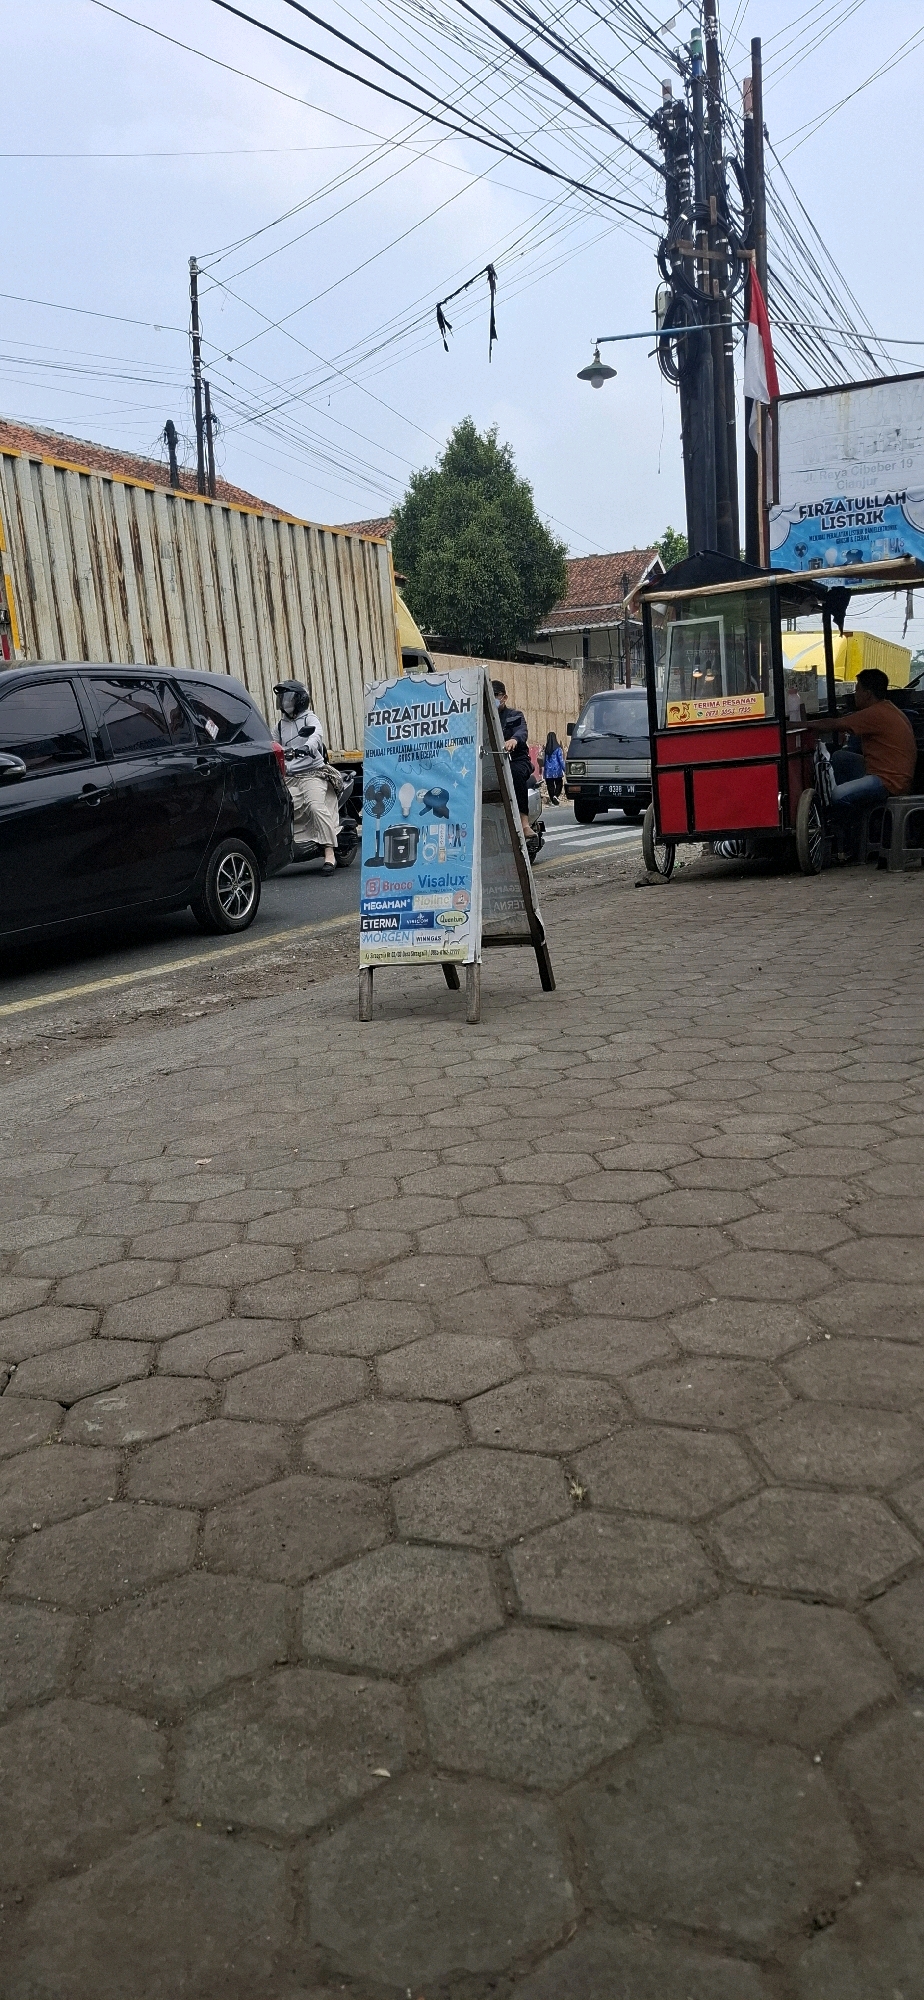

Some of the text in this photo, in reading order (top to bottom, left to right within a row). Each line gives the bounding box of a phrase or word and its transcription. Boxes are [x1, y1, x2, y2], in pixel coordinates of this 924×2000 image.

[850, 462, 896, 476] Cibeber
[901, 458, 913, 469] 19
[836, 477, 878, 490] Cianjur
[799, 491, 907, 518] FIRZATULLAH
[821, 510, 885, 531] LISTRIK
[693, 697, 756, 709] TERIMA PESANAN
[367, 697, 471, 727] FIRZATULLAH
[387, 719, 449, 741] LISTRIK
[382, 880, 413, 892] Broco
[417, 873, 466, 888] Visalux
[363, 899, 407, 911] MEGAMAN
[362, 917, 398, 930] ETERNA
[363, 930, 410, 943] MORGEN
